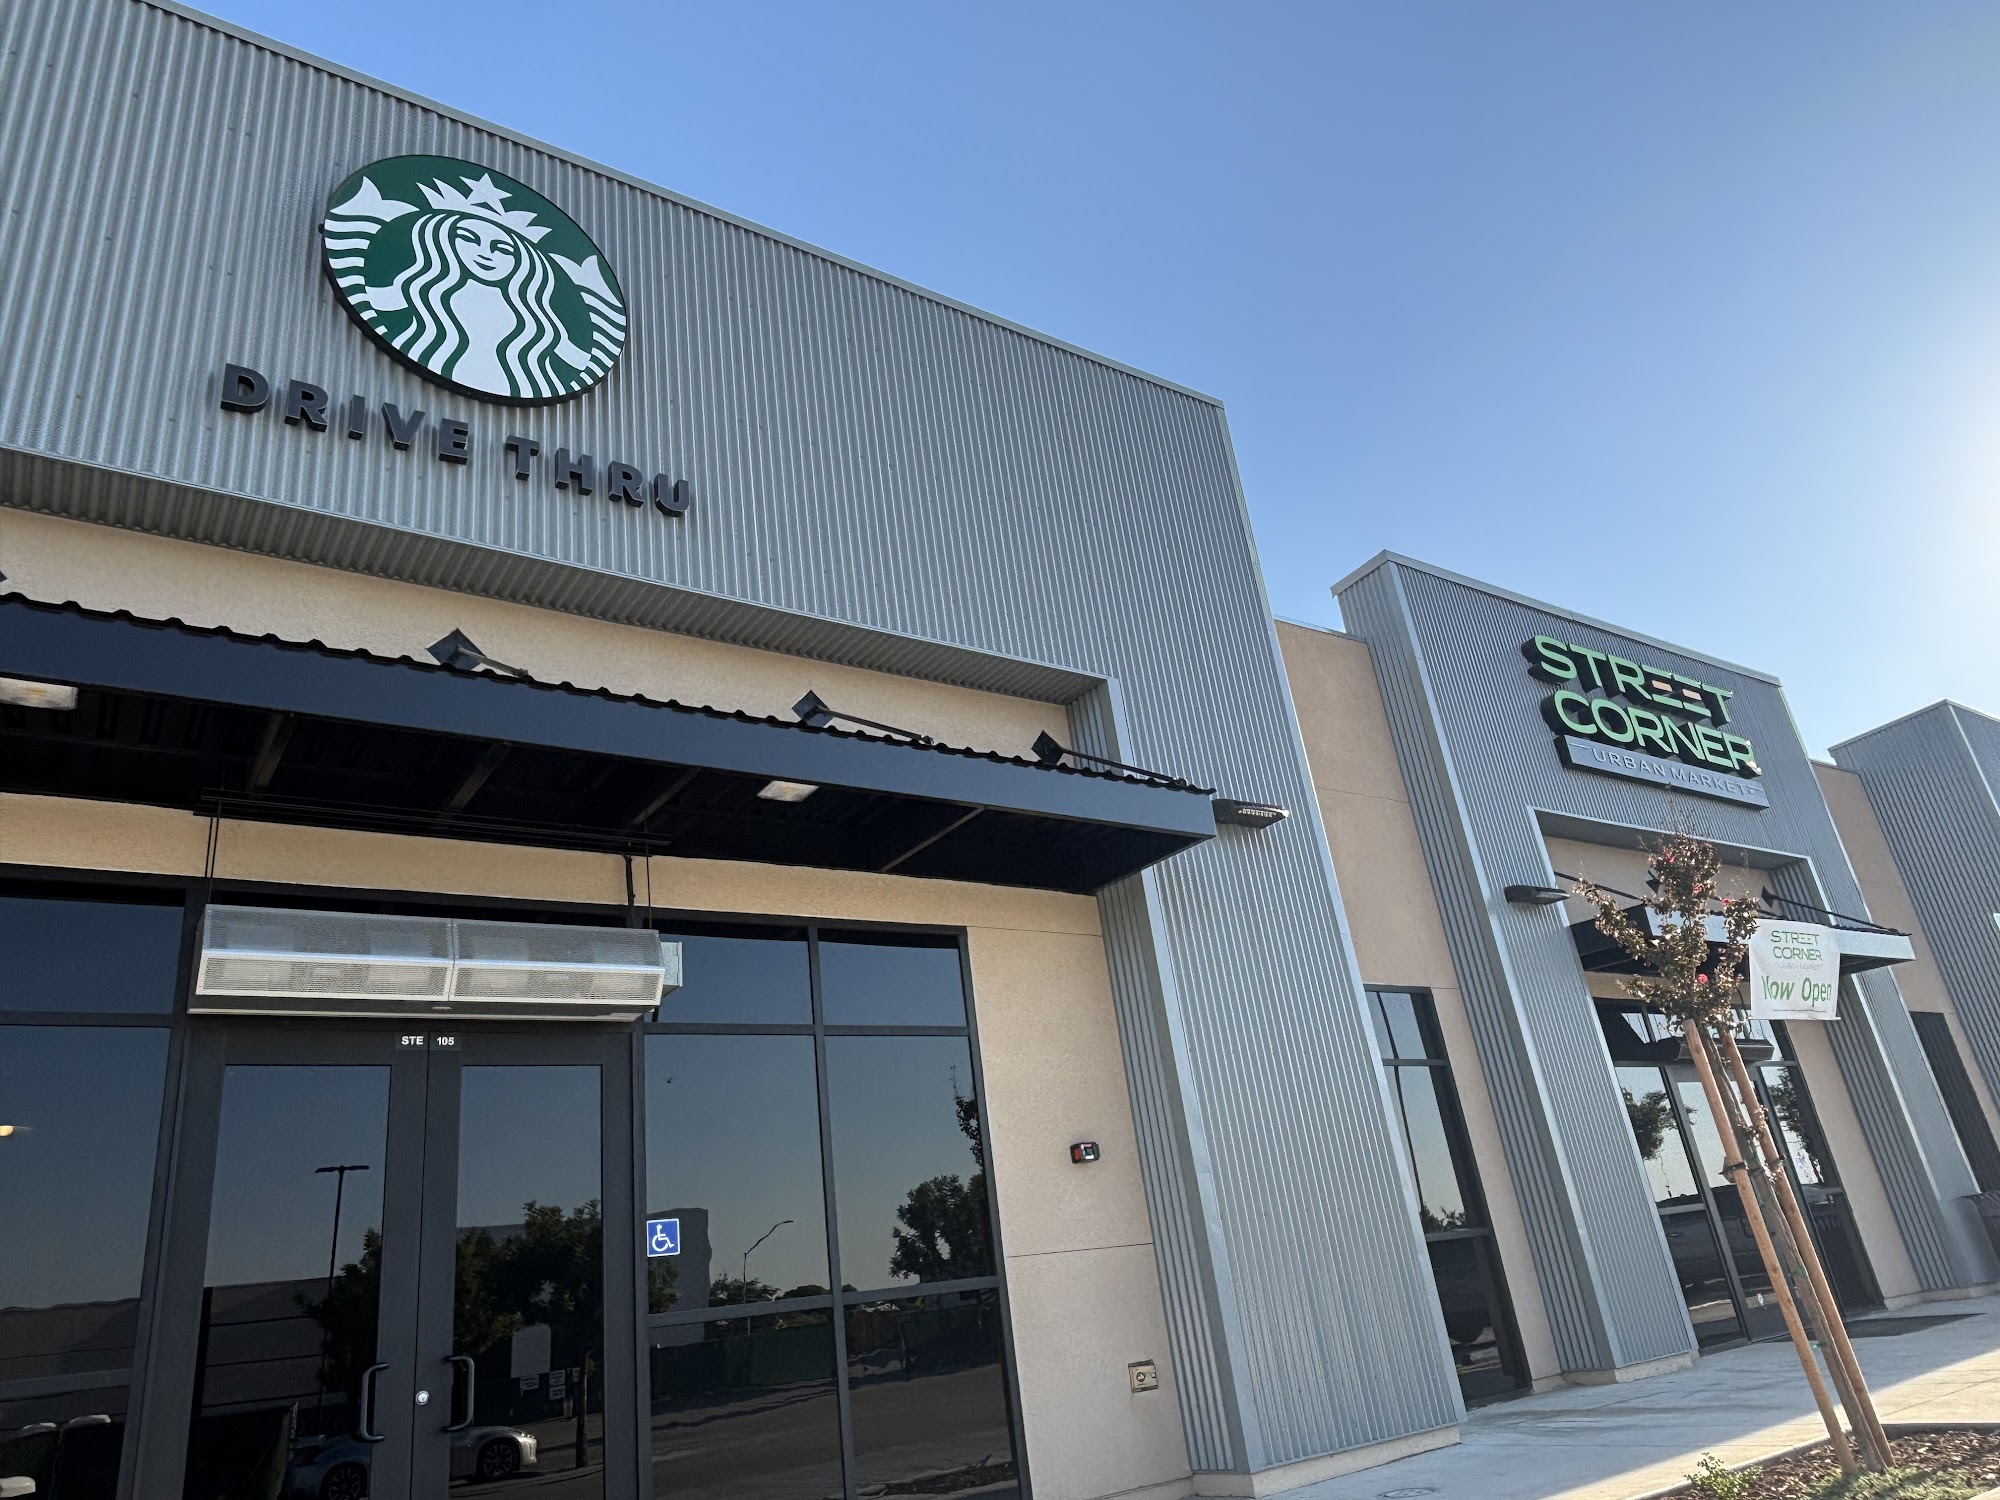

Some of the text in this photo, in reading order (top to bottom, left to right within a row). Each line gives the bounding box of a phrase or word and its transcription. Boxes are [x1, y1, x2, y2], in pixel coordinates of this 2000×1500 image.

[220, 363, 690, 518] DRIVE THRU
[1530, 634, 1734, 725] STREET
[1550, 689, 1762, 776] CORNER
[1590, 746, 1752, 797] URBAN MARKET
[1770, 930, 1820, 945] STREET
[1773, 946, 1824, 961] CORNER
[1761, 975, 1832, 1007] Now Open
[401, 1035, 455, 1046] STE 105
